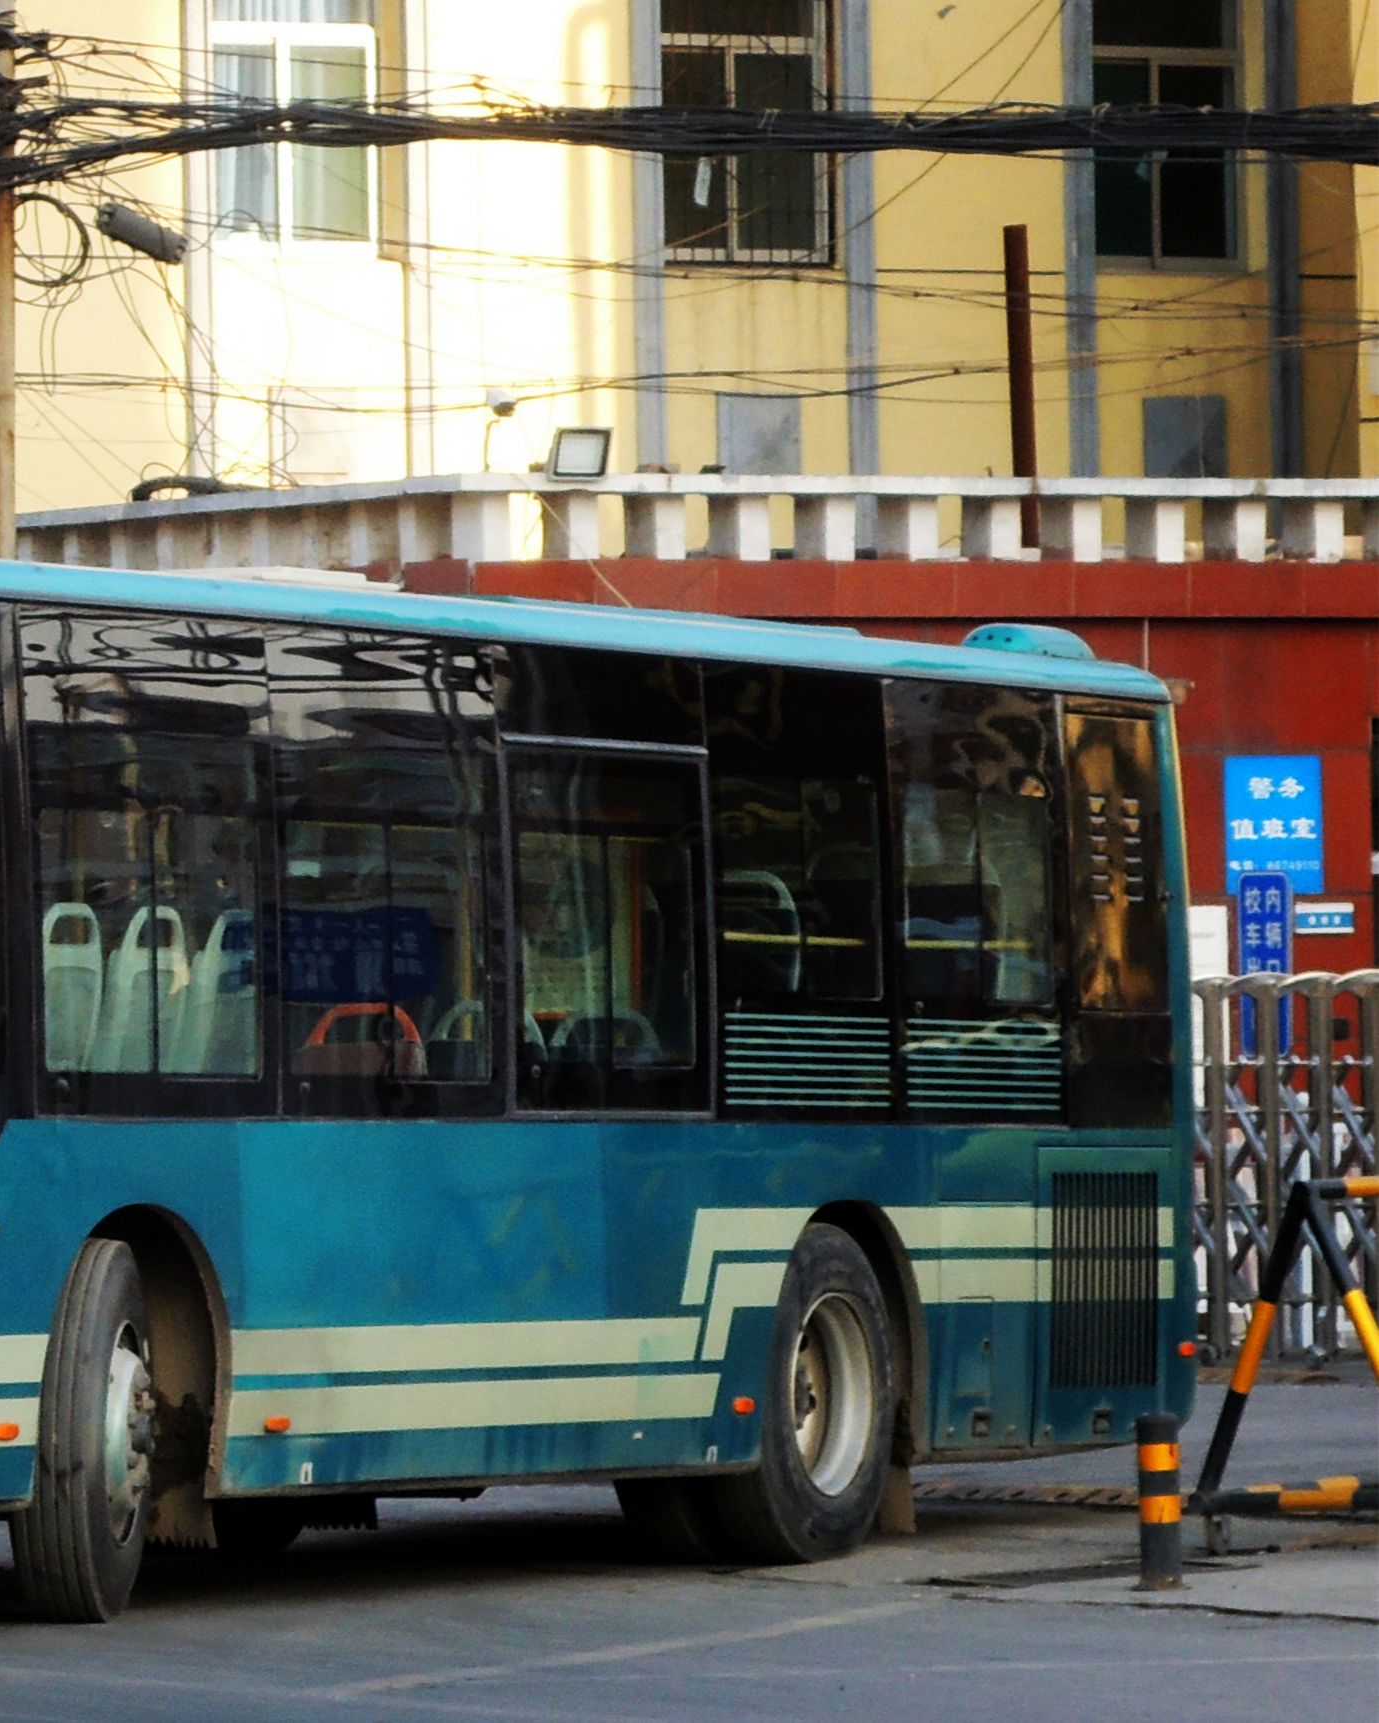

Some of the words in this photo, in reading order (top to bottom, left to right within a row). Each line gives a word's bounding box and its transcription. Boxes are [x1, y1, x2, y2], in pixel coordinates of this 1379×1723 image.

[1249, 777, 1305, 799] 警务
[1230, 817, 1317, 840] 值班室
